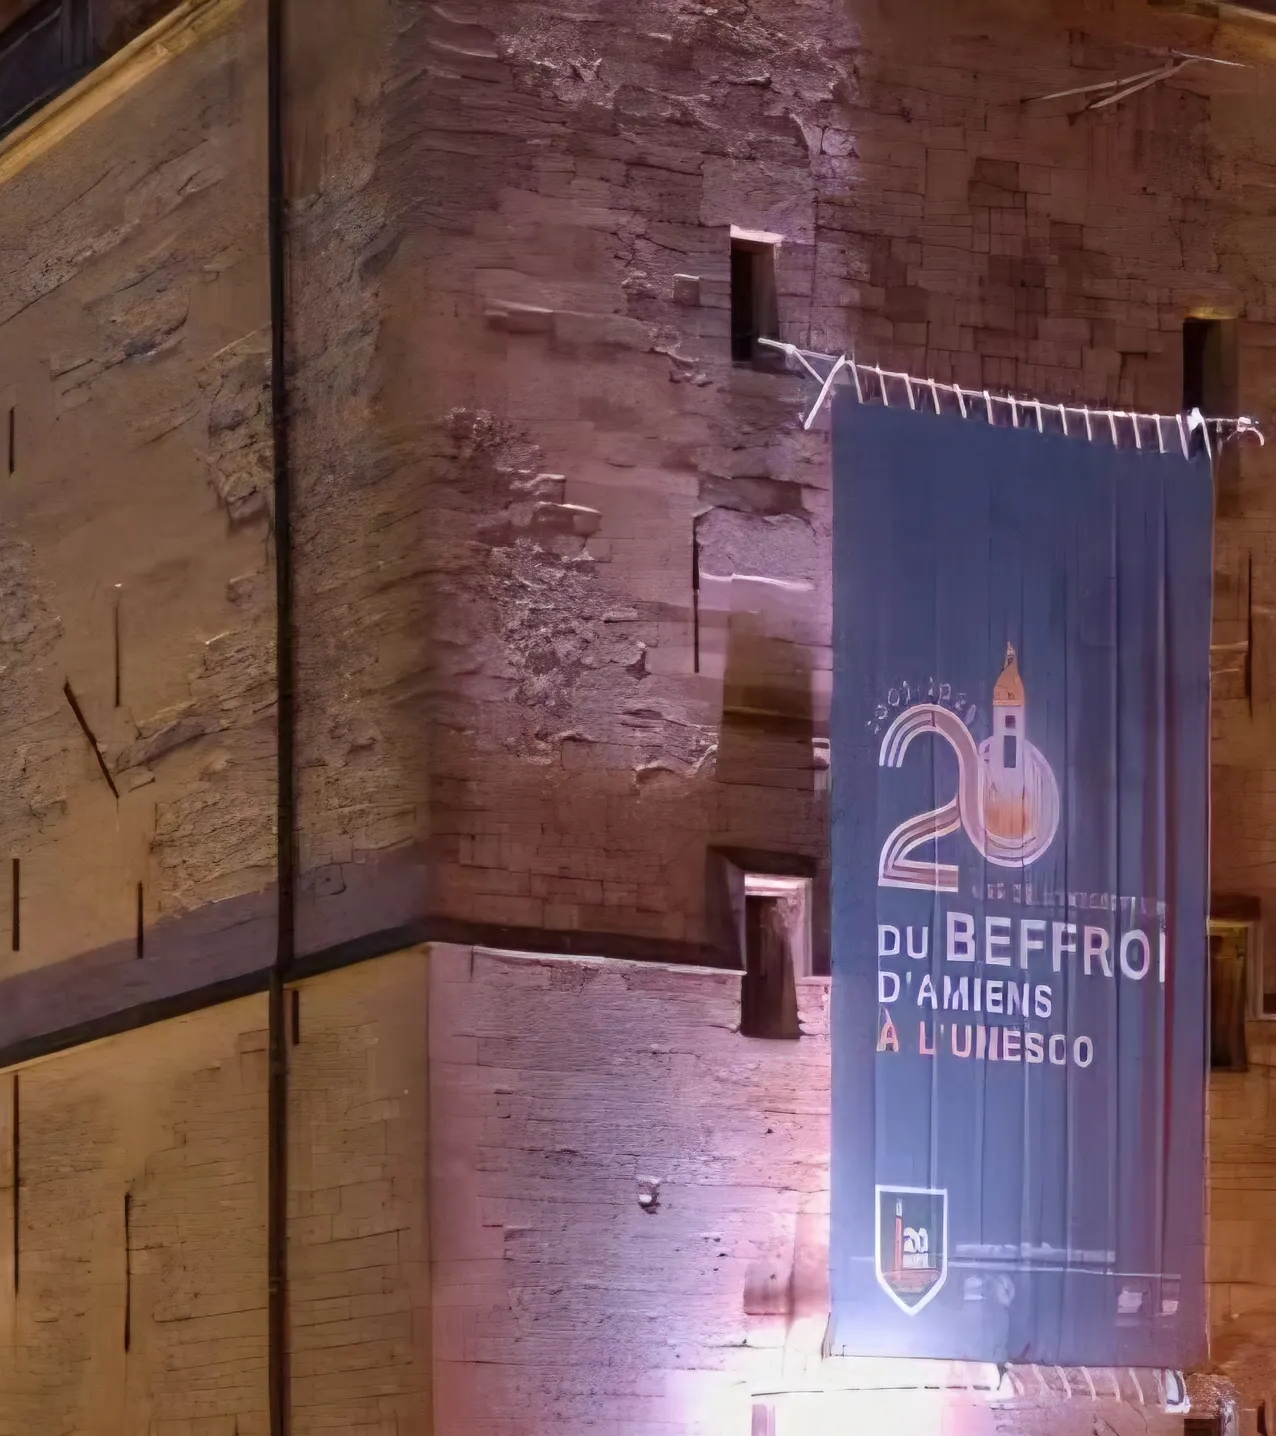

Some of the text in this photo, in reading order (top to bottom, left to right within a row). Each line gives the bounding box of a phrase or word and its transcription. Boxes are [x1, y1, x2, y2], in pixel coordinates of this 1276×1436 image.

[878, 910, 1168, 984] DU BEFFROI
[878, 970, 1053, 1019] D'AMIENS
[918, 1019, 1095, 1069] L'UNESCO
